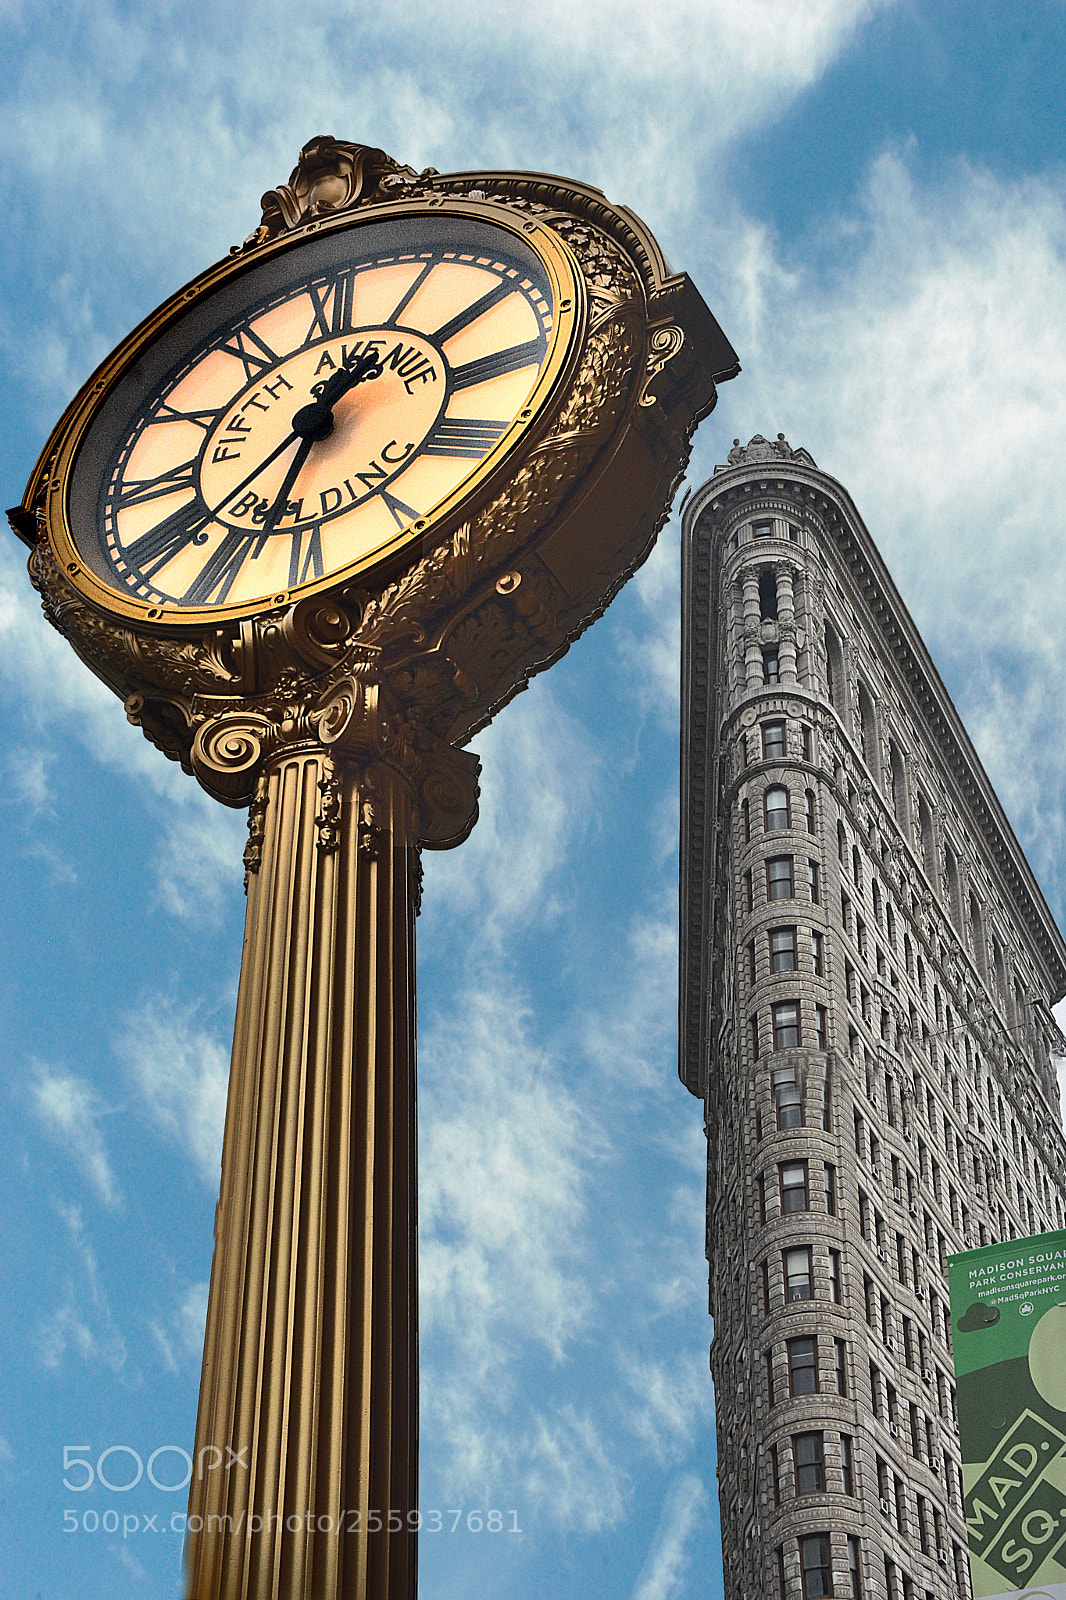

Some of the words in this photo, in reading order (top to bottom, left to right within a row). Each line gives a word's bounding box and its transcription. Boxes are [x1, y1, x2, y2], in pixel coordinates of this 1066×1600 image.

[212, 374, 294, 464] FIFTH
[228, 440, 415, 525] BLDING
[968, 1258, 1024, 1279] MADISON
[969, 1275, 997, 1289] PARK
[999, 1261, 1066, 1282] CONSERVAN
[990, 1284, 1060, 1306] @MadSqParkNYC
[966, 1441, 1050, 1542] MAD.
[1001, 1508, 1066, 1574] SQ.
